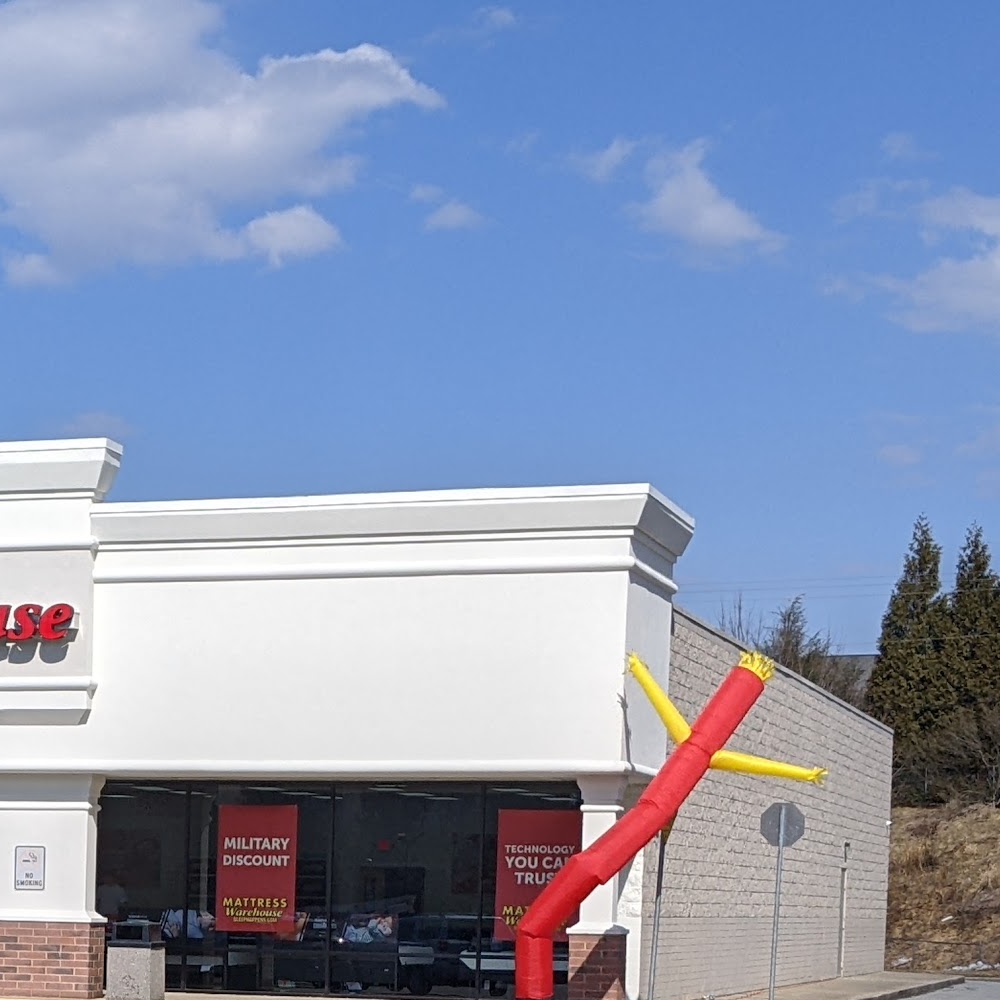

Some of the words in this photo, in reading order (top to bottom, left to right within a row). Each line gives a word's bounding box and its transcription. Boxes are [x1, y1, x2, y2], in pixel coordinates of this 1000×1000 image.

[223, 837, 290, 850] MILITARY
[505, 844, 576, 855] TECHNOLOGY
[222, 855, 290, 867] DISCOUNT
[505, 856, 538, 869] YOU
[514, 872, 558, 885] TRUS
[222, 898, 287, 908] MATTRESS
[225, 907, 283, 917] Warehouse
